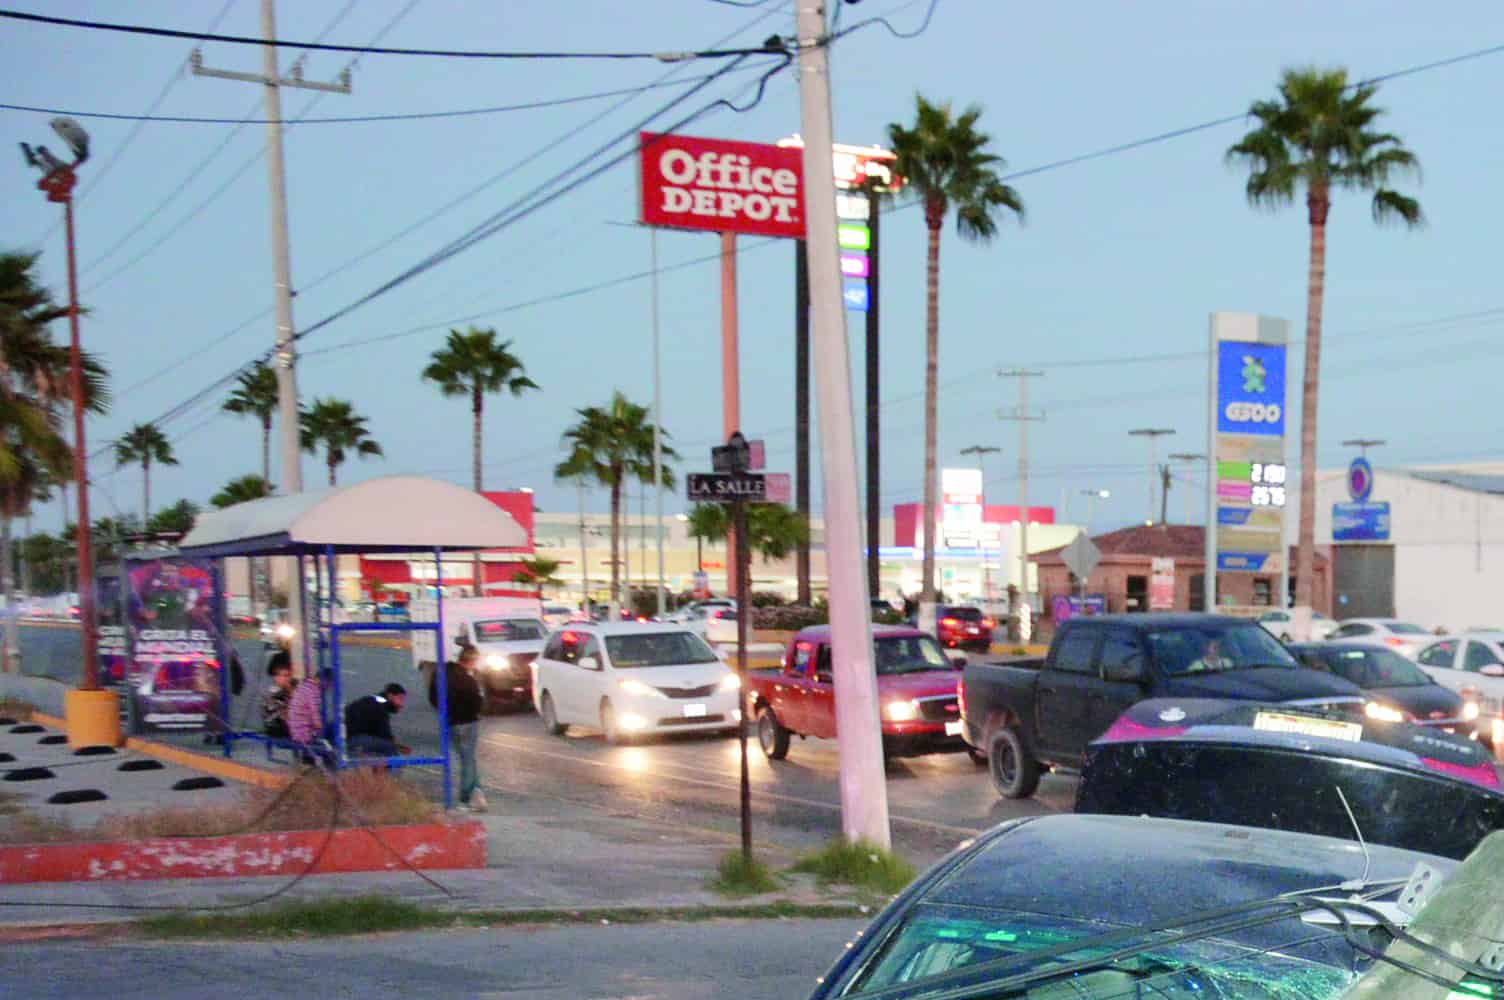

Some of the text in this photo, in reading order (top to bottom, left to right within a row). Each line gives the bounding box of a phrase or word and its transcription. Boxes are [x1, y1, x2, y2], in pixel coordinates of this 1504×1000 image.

[659, 149, 797, 194] Office
[661, 187, 798, 222] DEPOT
[691, 480, 765, 494] LA SALLE
